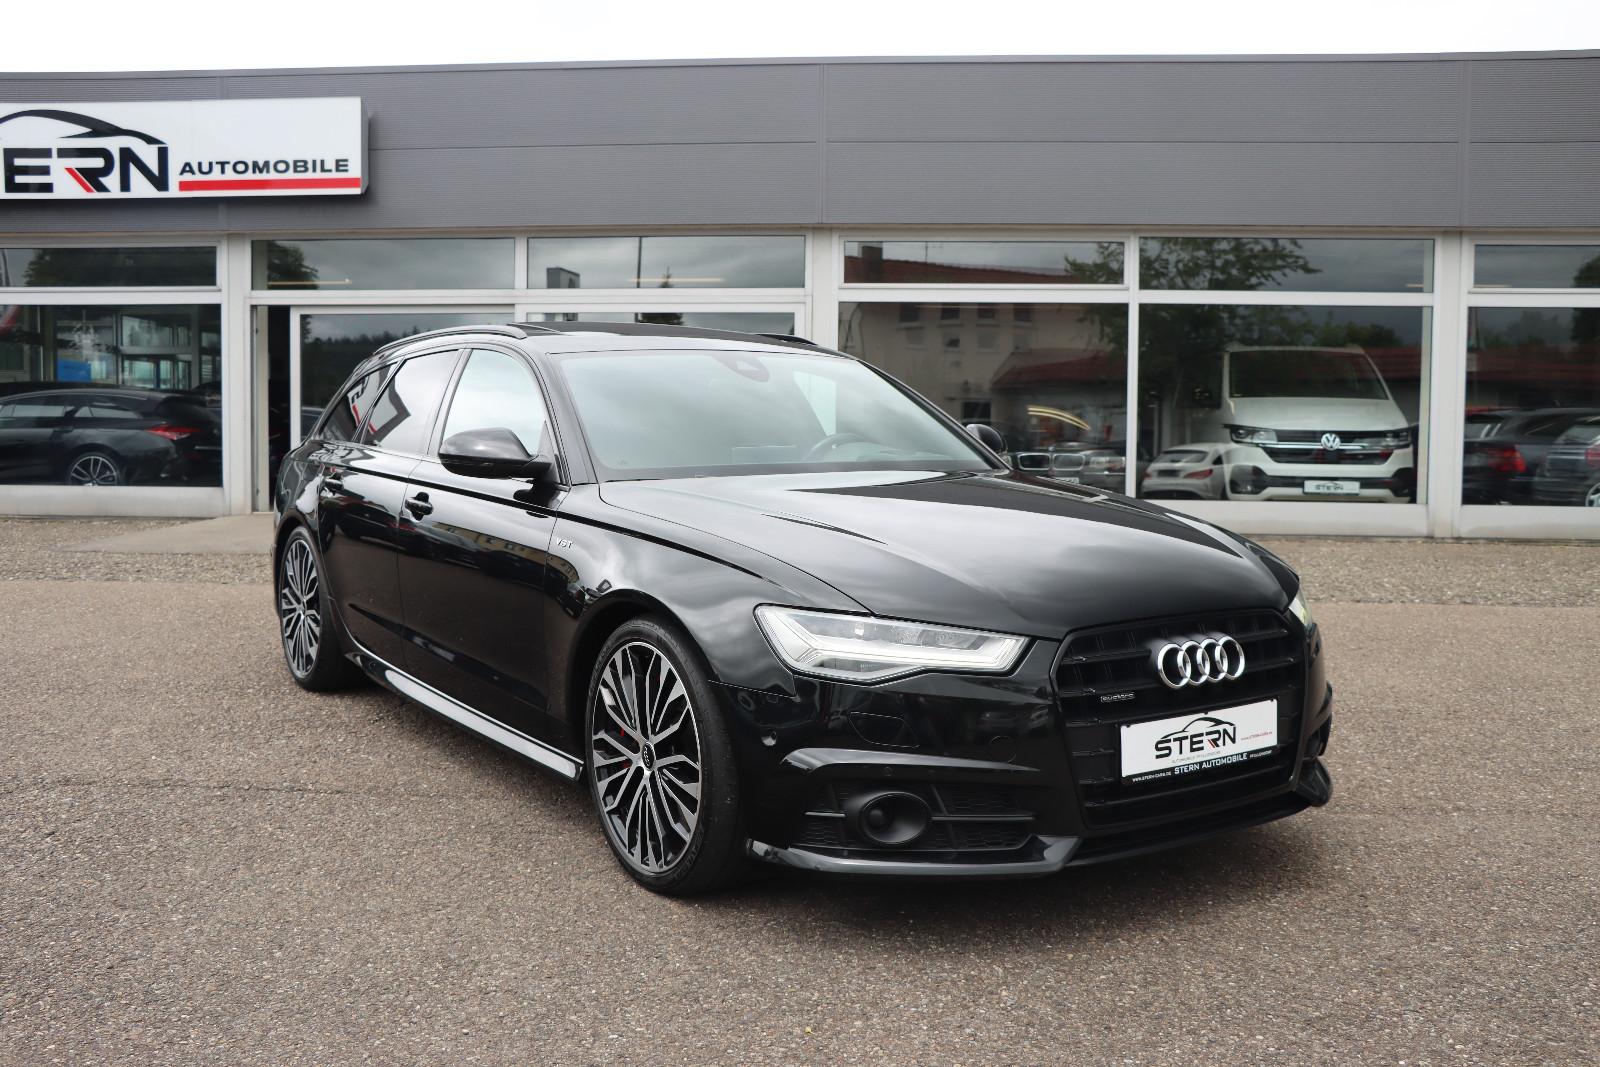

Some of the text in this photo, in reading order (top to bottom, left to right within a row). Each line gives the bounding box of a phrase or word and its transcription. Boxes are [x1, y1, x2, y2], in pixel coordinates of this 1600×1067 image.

[179, 158, 349, 176] AUTOMOBILE
[1155, 726, 1236, 760] STERN
[1174, 762, 1200, 775] STERN
[1201, 752, 1248, 769] AUTOMOBILE
